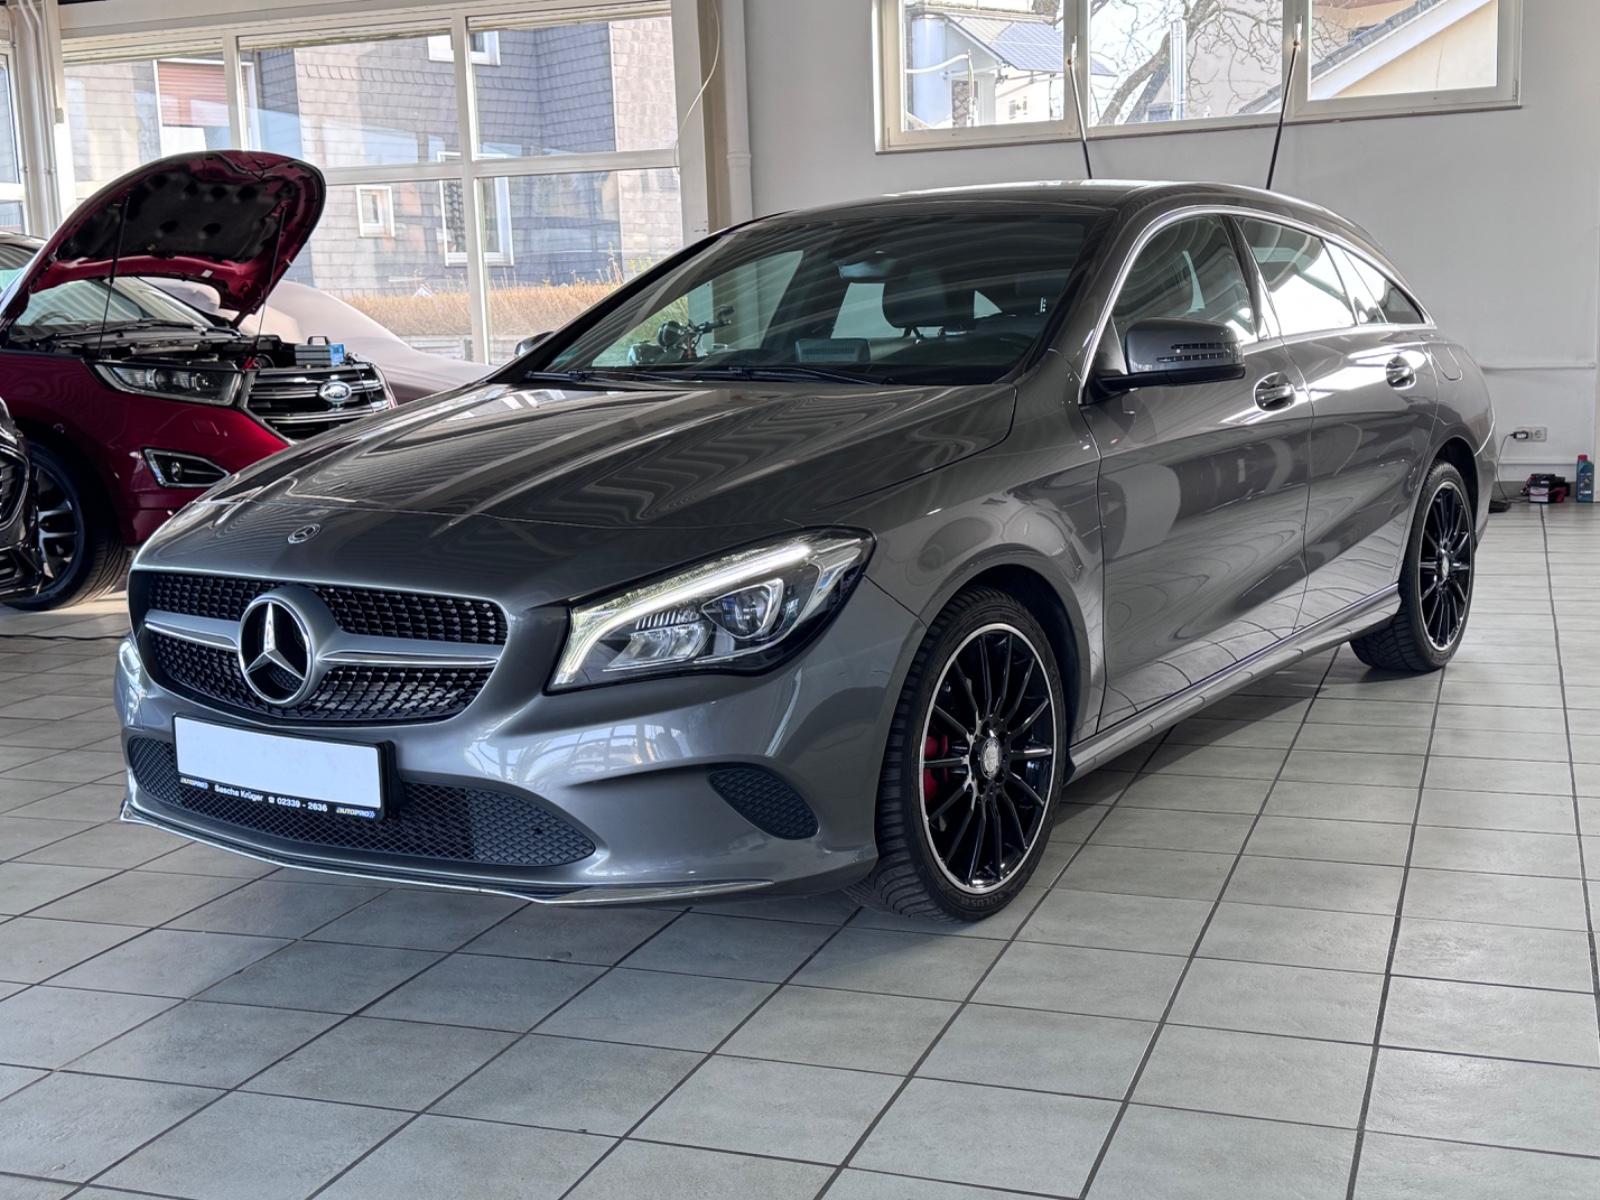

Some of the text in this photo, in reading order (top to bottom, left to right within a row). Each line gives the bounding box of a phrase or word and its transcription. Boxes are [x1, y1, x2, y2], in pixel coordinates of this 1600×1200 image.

[215, 783, 240, 797] Sascha
[240, 790, 264, 802] Krüger
[276, 796, 301, 809] 02339
